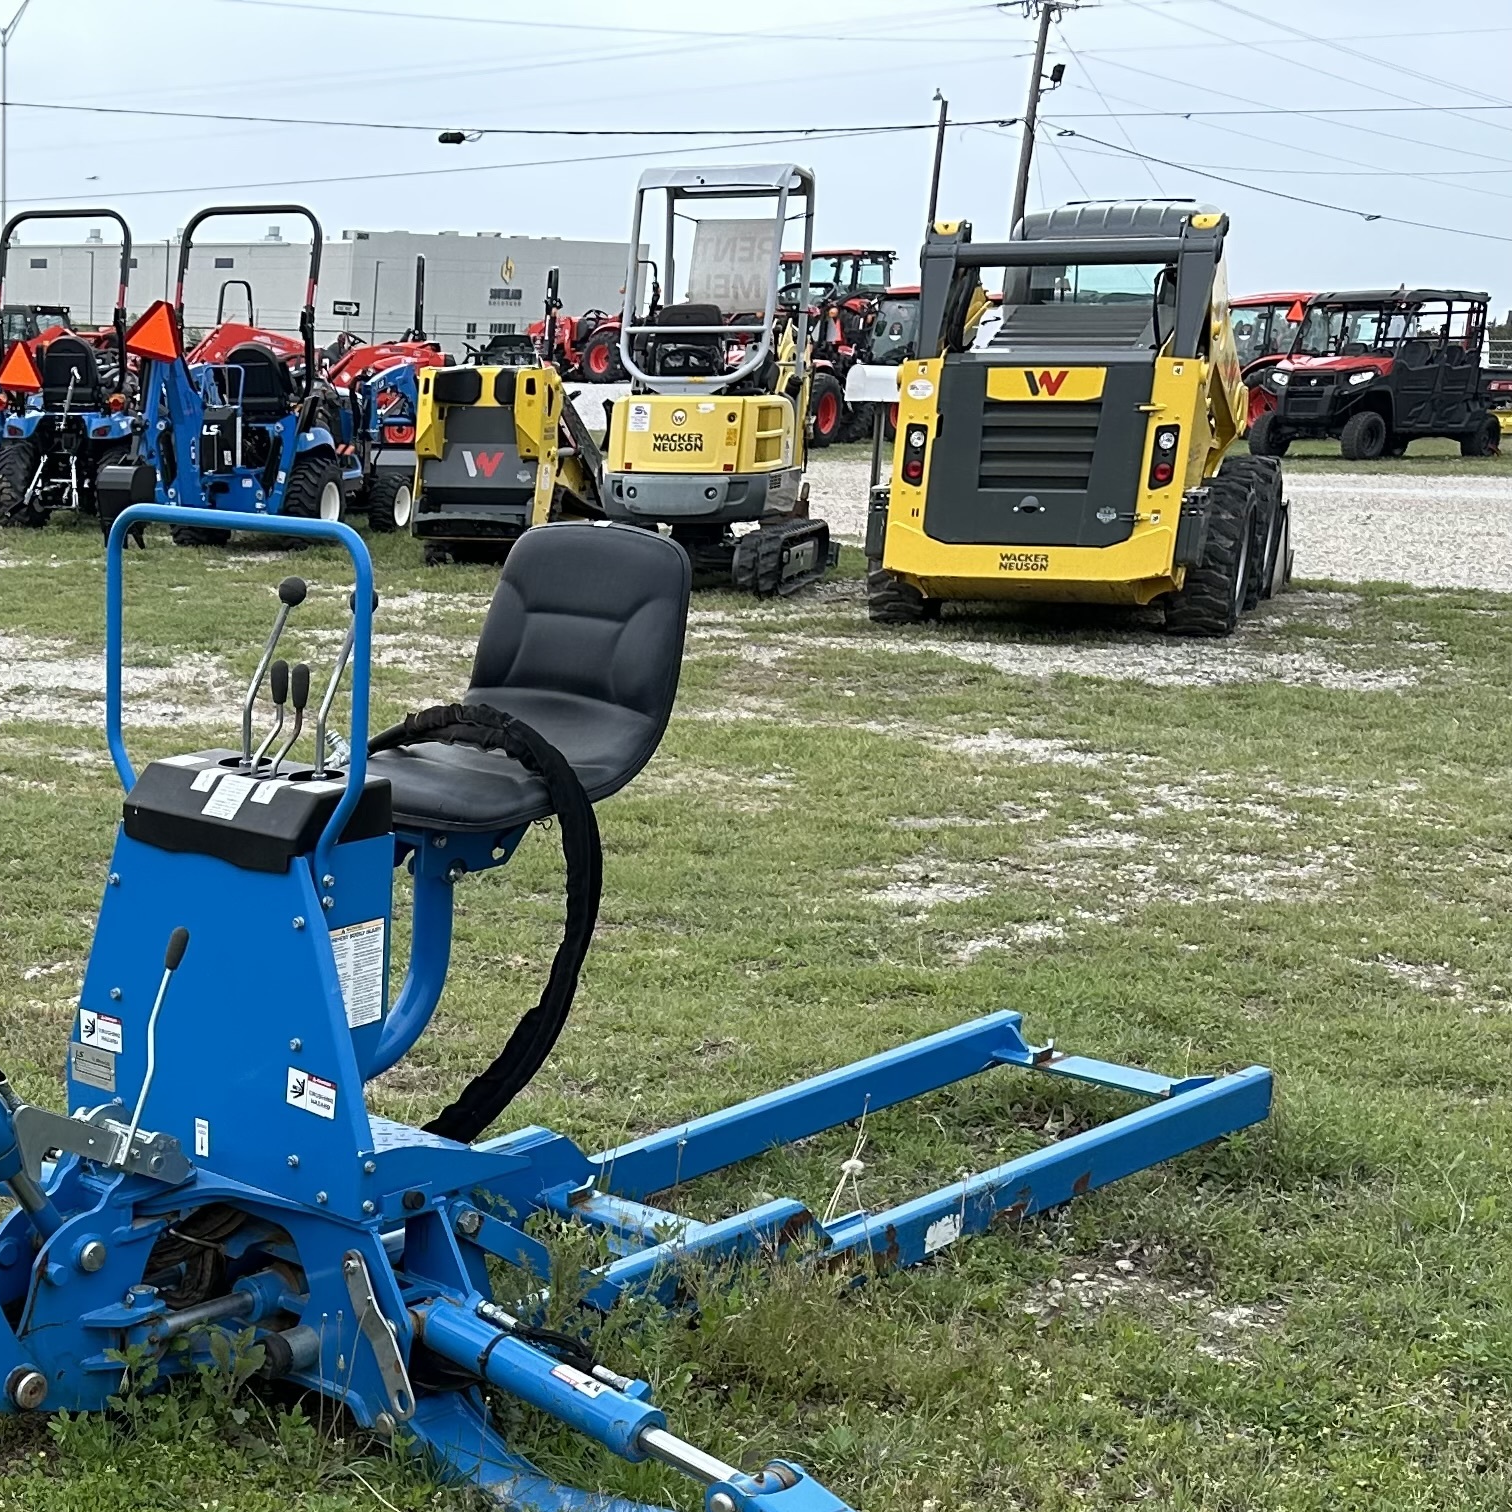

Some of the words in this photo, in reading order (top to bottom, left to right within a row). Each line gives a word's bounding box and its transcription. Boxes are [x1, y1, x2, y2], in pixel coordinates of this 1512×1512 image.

[202, 424, 219, 436] LS
[652, 433, 703, 443] WACKER
[652, 443, 704, 452] NEUSON
[999, 552, 1049, 562] WACKER
[999, 562, 1049, 571] NEUSON
